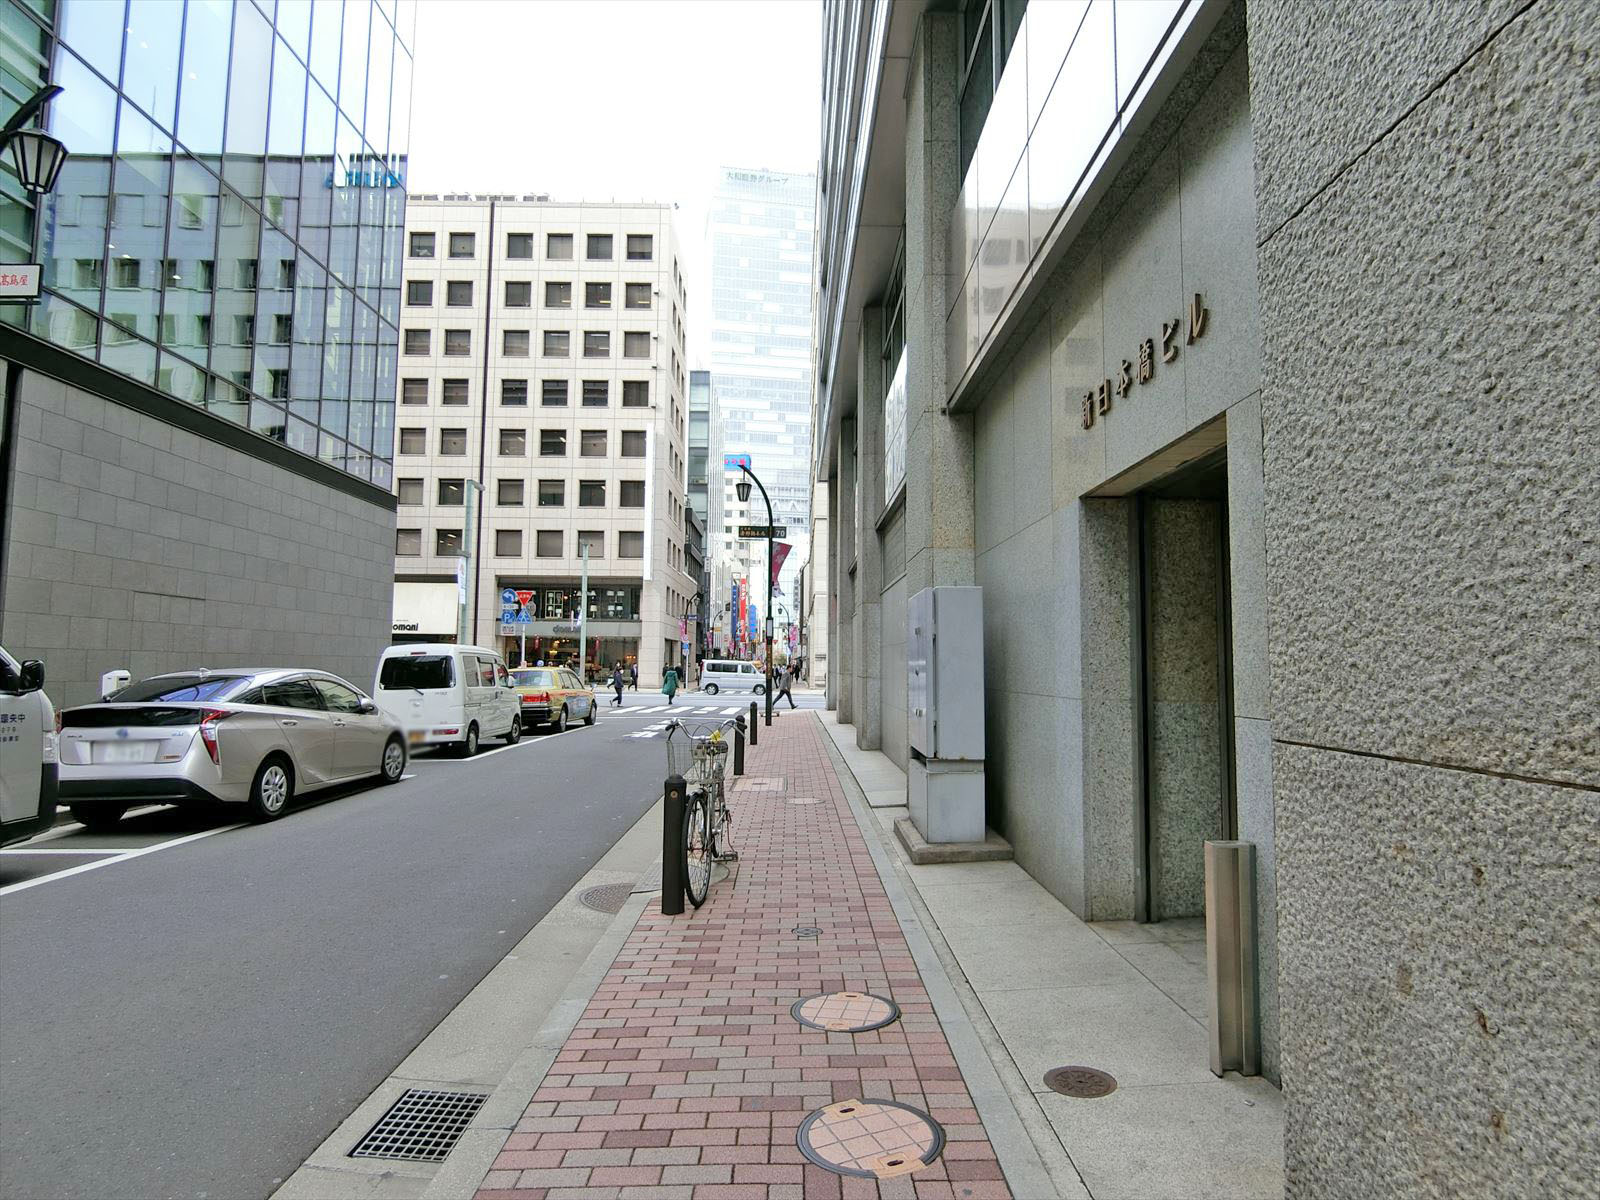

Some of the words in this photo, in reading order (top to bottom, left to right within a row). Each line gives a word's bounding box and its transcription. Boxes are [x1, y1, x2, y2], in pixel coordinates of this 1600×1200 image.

[1081, 292, 1209, 430] 新日本橋ビル
